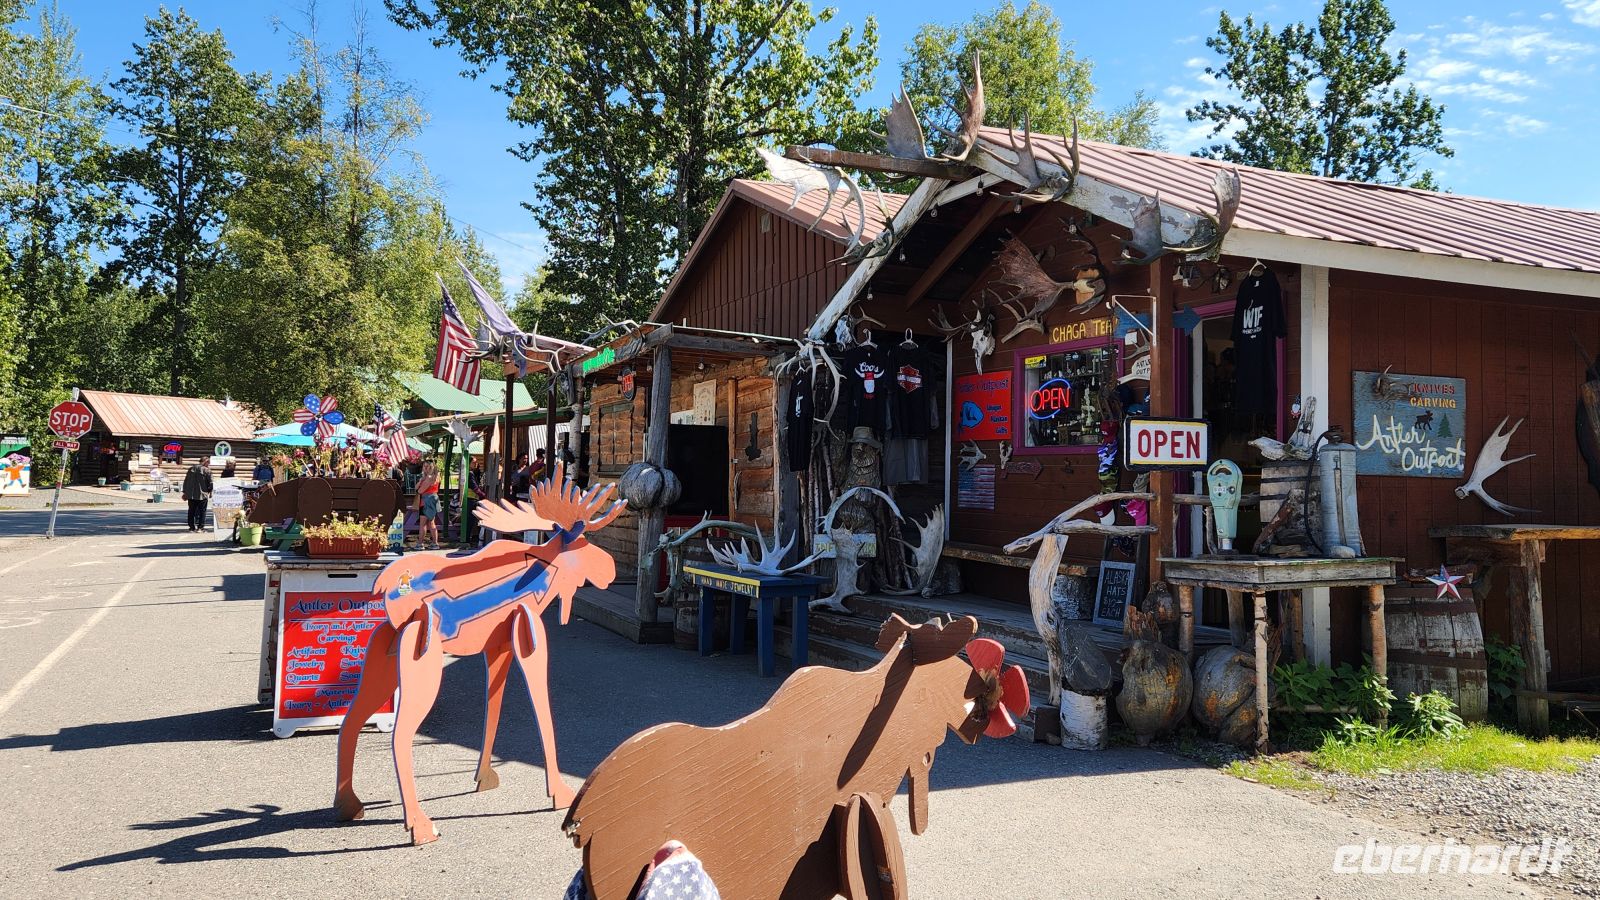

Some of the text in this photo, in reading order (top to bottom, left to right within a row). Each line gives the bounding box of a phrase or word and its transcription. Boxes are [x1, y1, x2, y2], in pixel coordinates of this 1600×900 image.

[1052, 318, 1113, 342] CHAGA TEA
[1413, 383, 1455, 394] KNIVES
[1030, 387, 1070, 412] OPEN
[1410, 397, 1456, 408] CARVING
[52, 411, 90, 428] STOP
[1355, 414, 1425, 454] Antler
[1137, 429, 1200, 459] OPEN
[1401, 438, 1466, 474] Outpost
[1106, 585, 1126, 597] HATS
[290, 598, 385, 616] Antler Outpos
[302, 620, 375, 634] Ivory and Antler
[318, 634, 357, 644] Carvings
[287, 645, 367, 658] Artifacts Kniv
[286, 659, 324, 671] Jewelry
[286, 673, 320, 685] Quartz
[285, 700, 312, 712] Ivory
